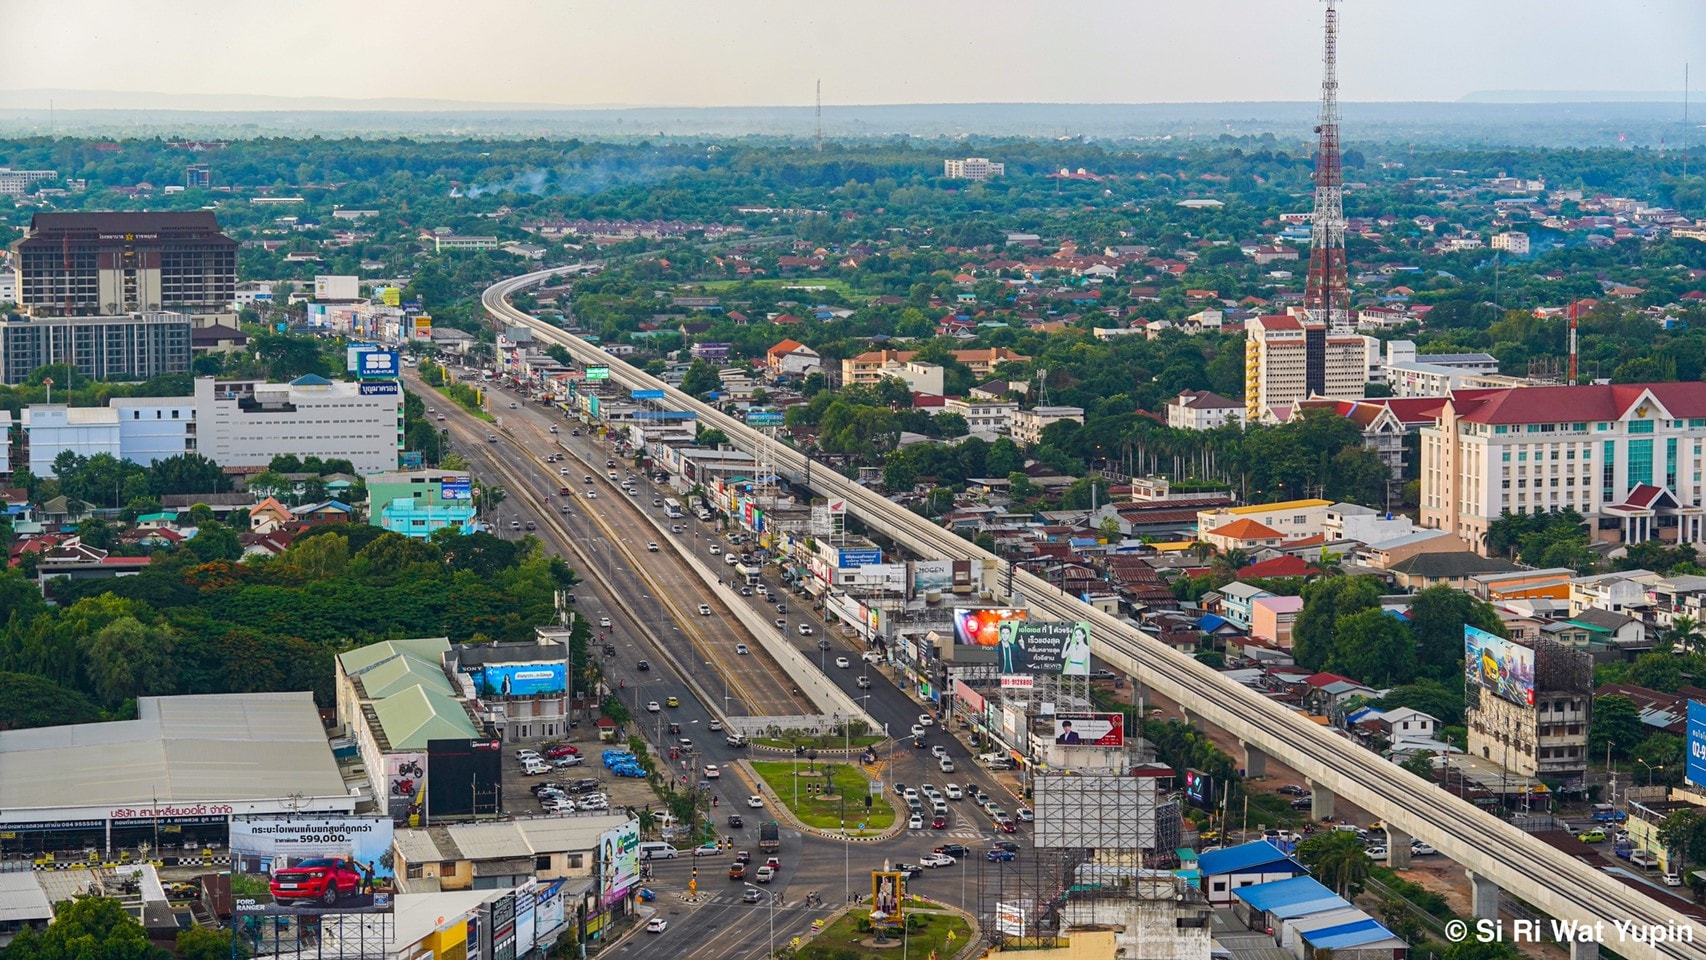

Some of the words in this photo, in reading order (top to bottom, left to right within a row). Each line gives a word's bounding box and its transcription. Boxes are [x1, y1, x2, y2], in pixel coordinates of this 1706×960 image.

[1692, 740, 1706, 760] 02-9
[110, 809, 137, 818] บริษัท
[210, 804, 233, 814] จำกัด
[299, 834, 345, 843] 599,000
